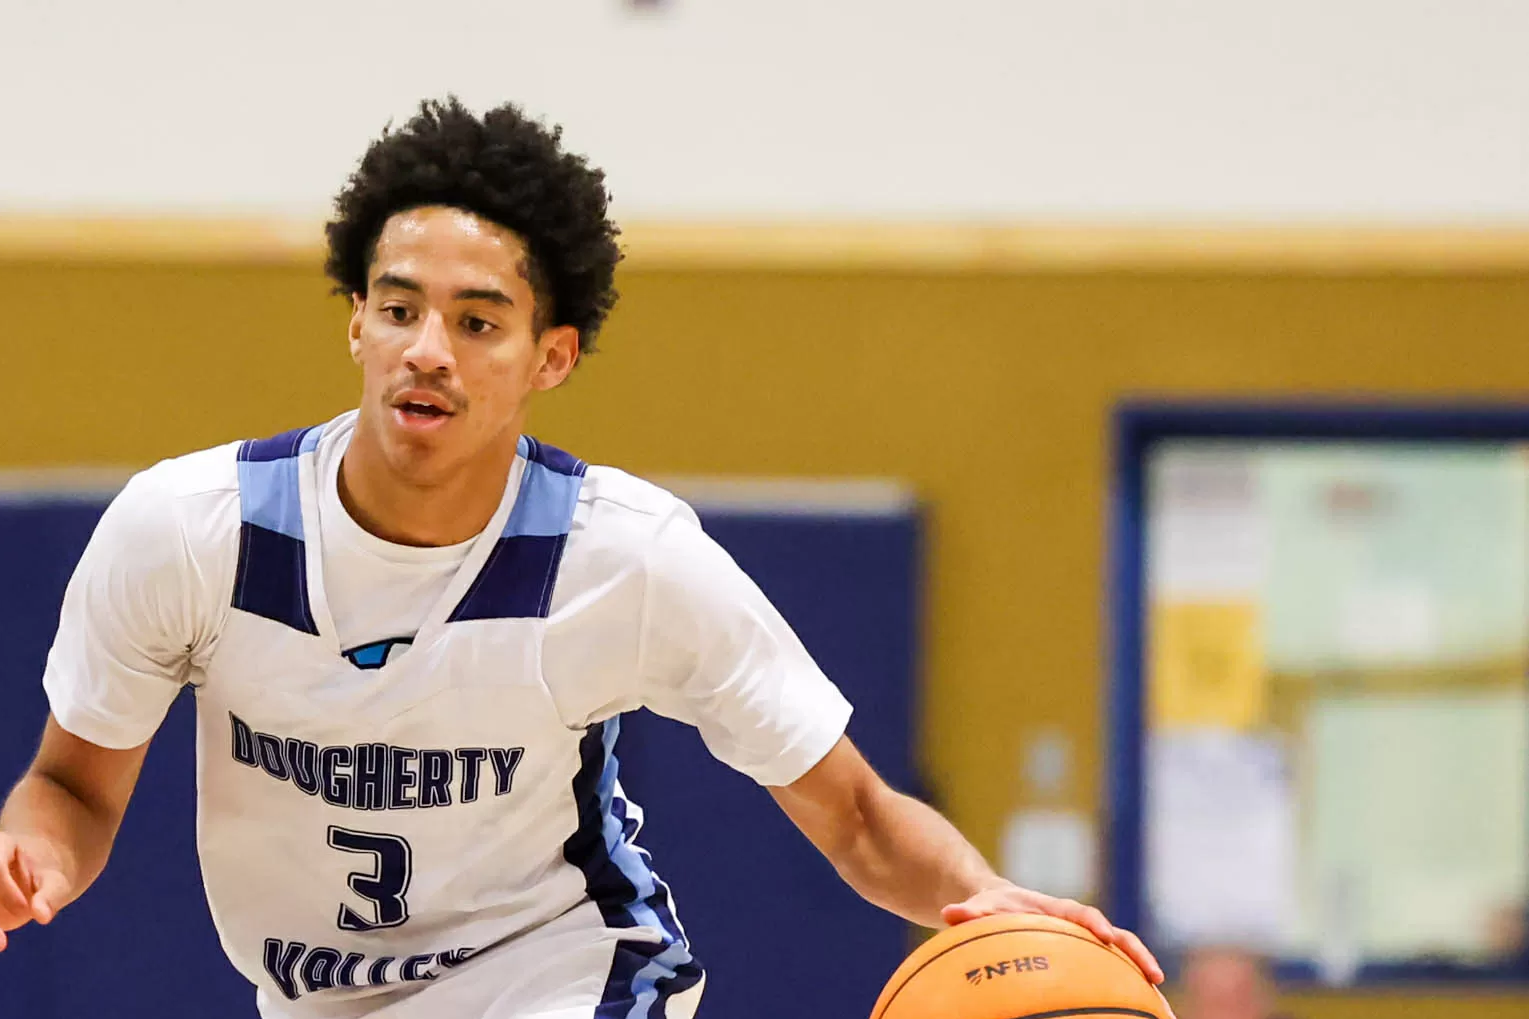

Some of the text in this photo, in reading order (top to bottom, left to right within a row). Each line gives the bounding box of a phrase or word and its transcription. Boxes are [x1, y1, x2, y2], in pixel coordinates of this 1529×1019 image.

[229, 710, 525, 811] DOUGHERTY
[327, 825, 412, 931] 3
[984, 956, 1049, 980] NFHS
